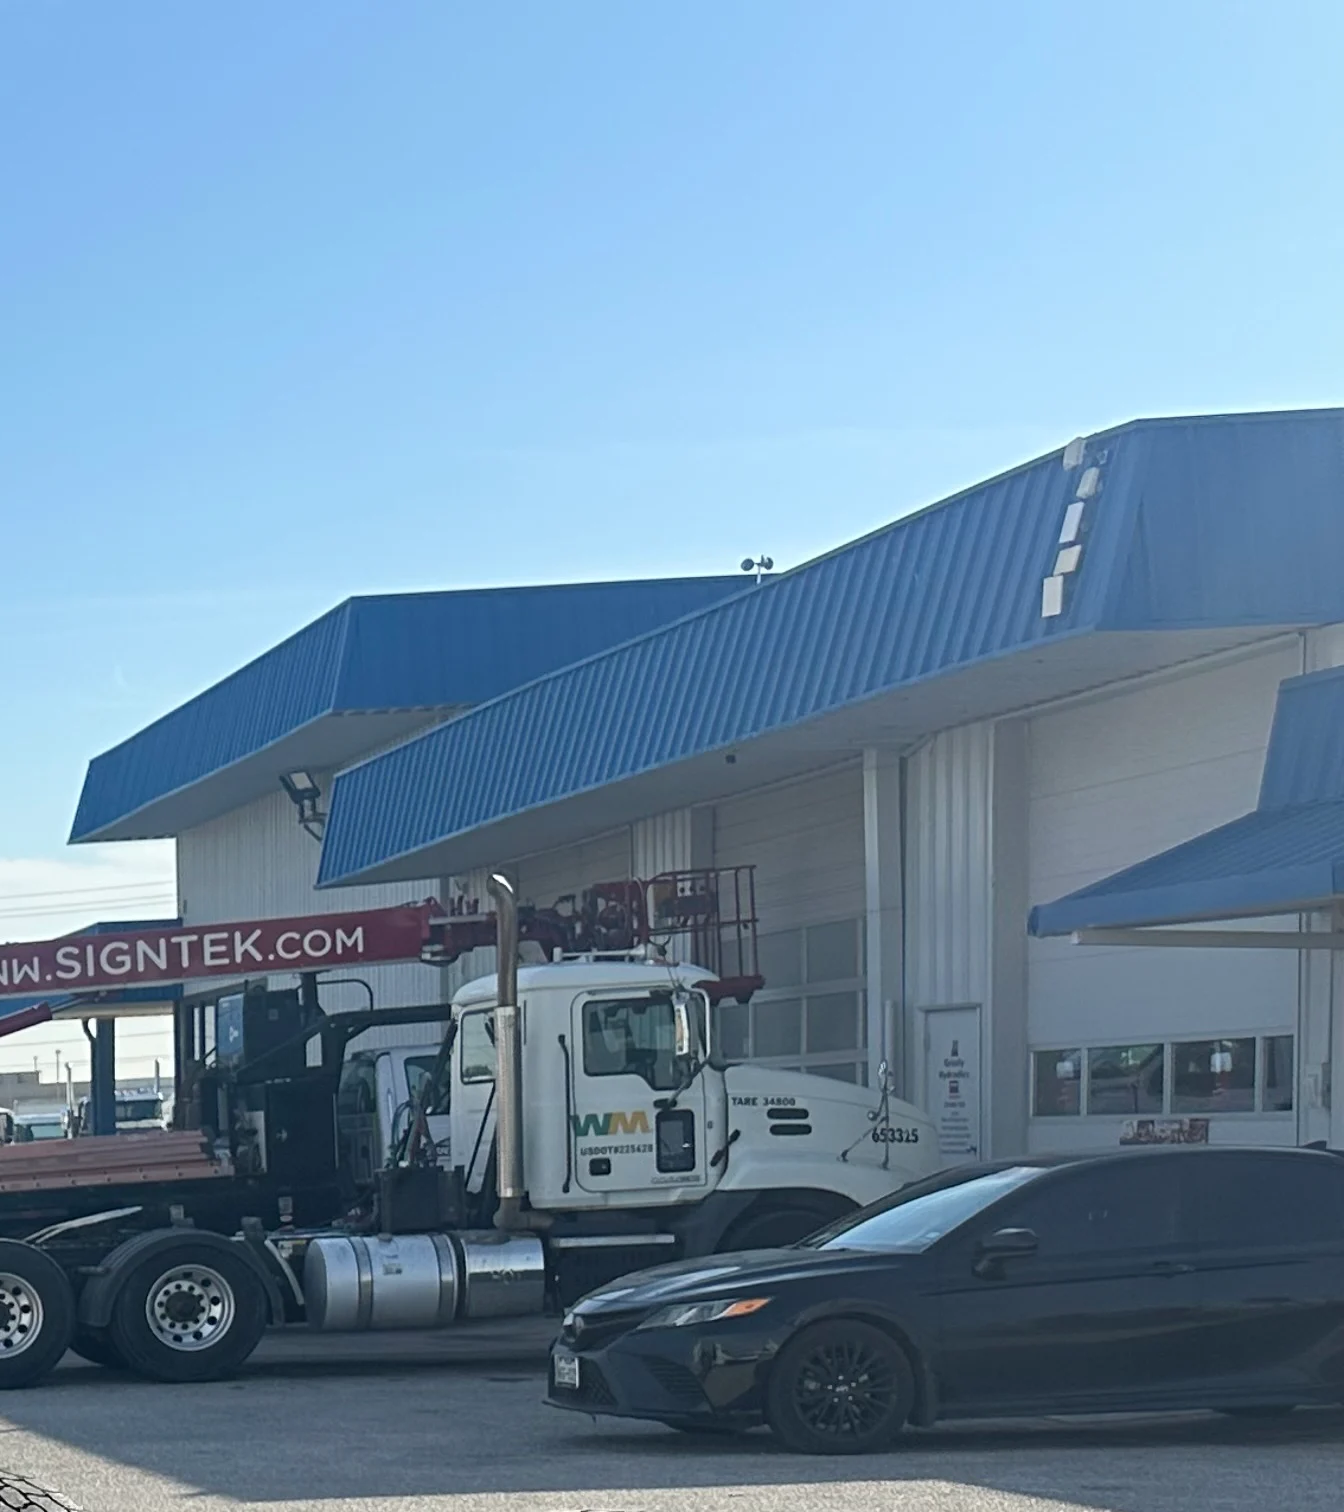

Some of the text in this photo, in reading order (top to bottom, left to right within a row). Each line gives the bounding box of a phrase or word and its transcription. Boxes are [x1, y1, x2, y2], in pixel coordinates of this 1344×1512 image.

[731, 1097, 796, 1107] TARE 34800
[571, 1110, 650, 1137] WM
[871, 1127, 919, 1143] 653325
